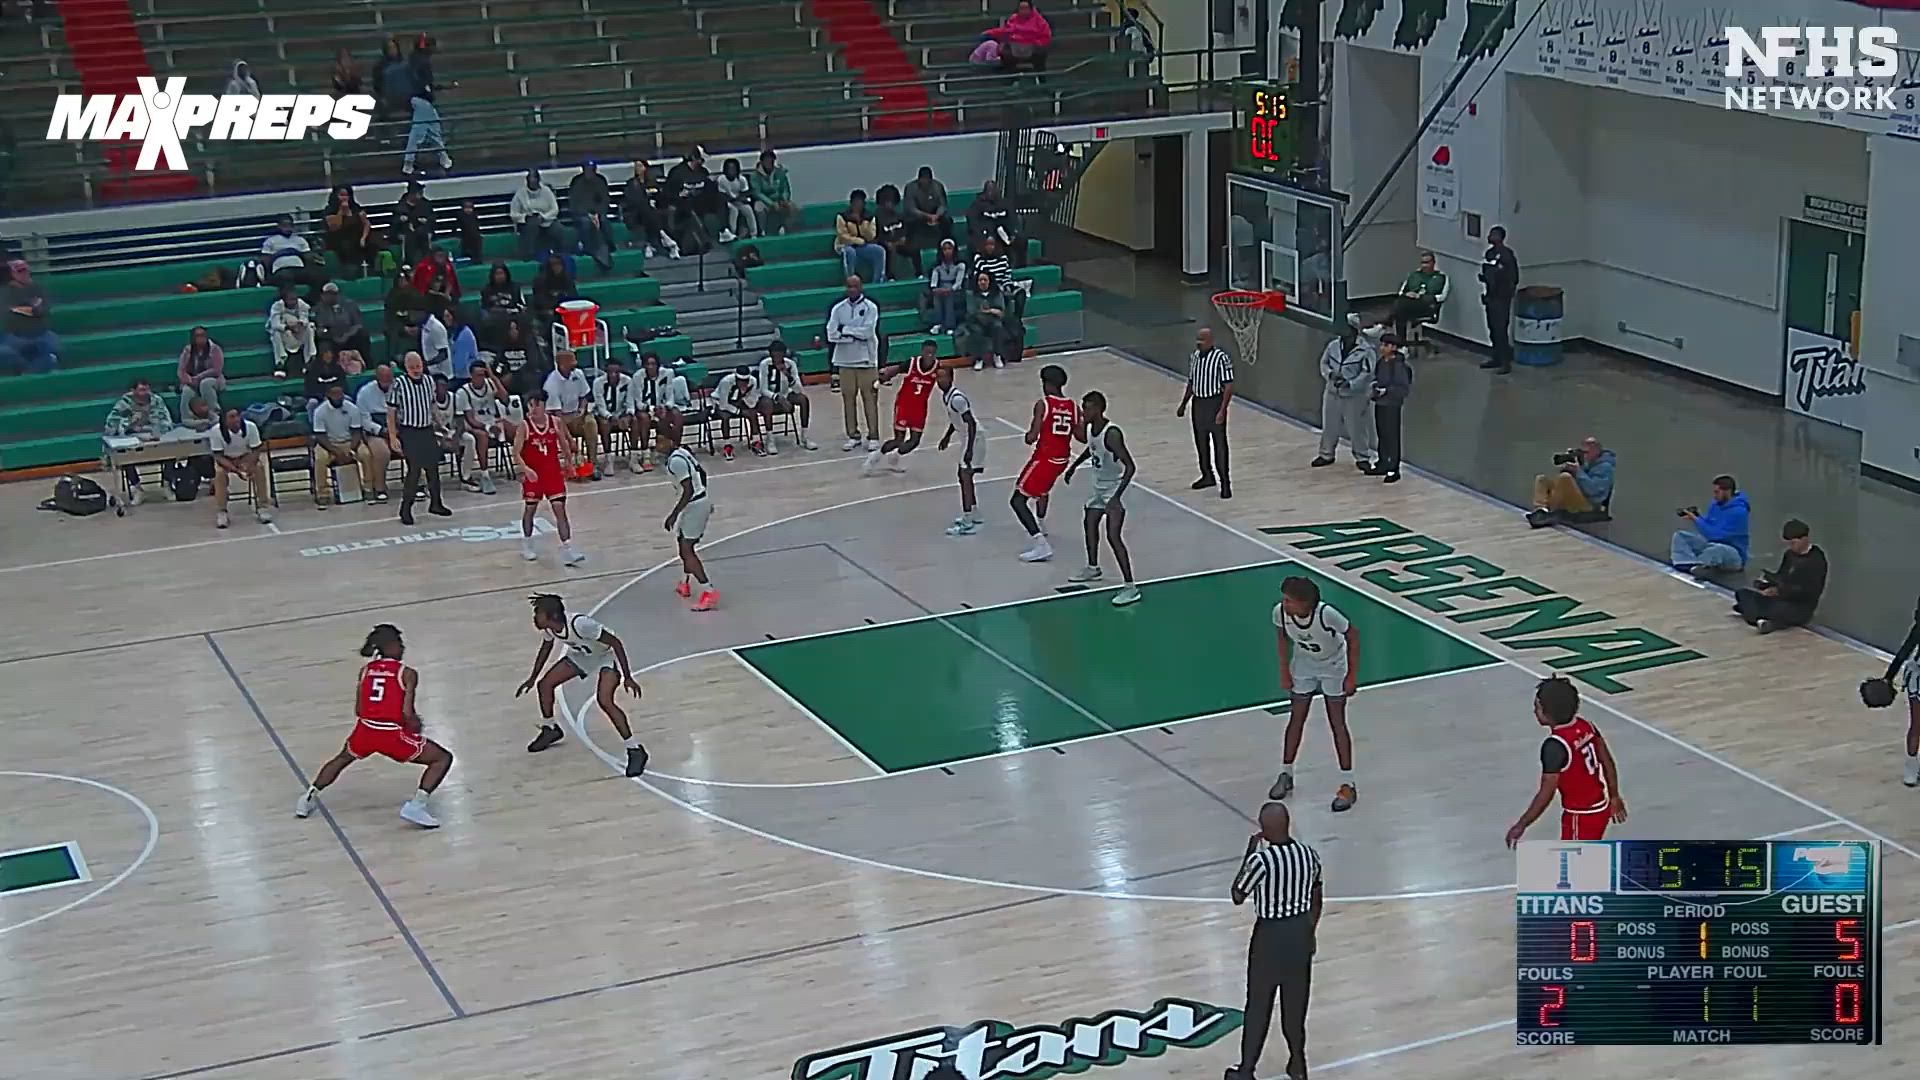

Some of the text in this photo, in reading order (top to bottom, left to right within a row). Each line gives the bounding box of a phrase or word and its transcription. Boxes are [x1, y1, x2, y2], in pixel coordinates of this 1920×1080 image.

[1676, 60, 1684, 73] 8
[1711, 51, 1719, 65] 4
[1256, 91, 1287, 119] 5:15
[1905, 94, 1914, 109] 8
[1052, 414, 1072, 435] 25
[1258, 517, 1708, 694] ARSENAL
[370, 678, 386, 701] 5
[794, 998, 1240, 1080] Titans
